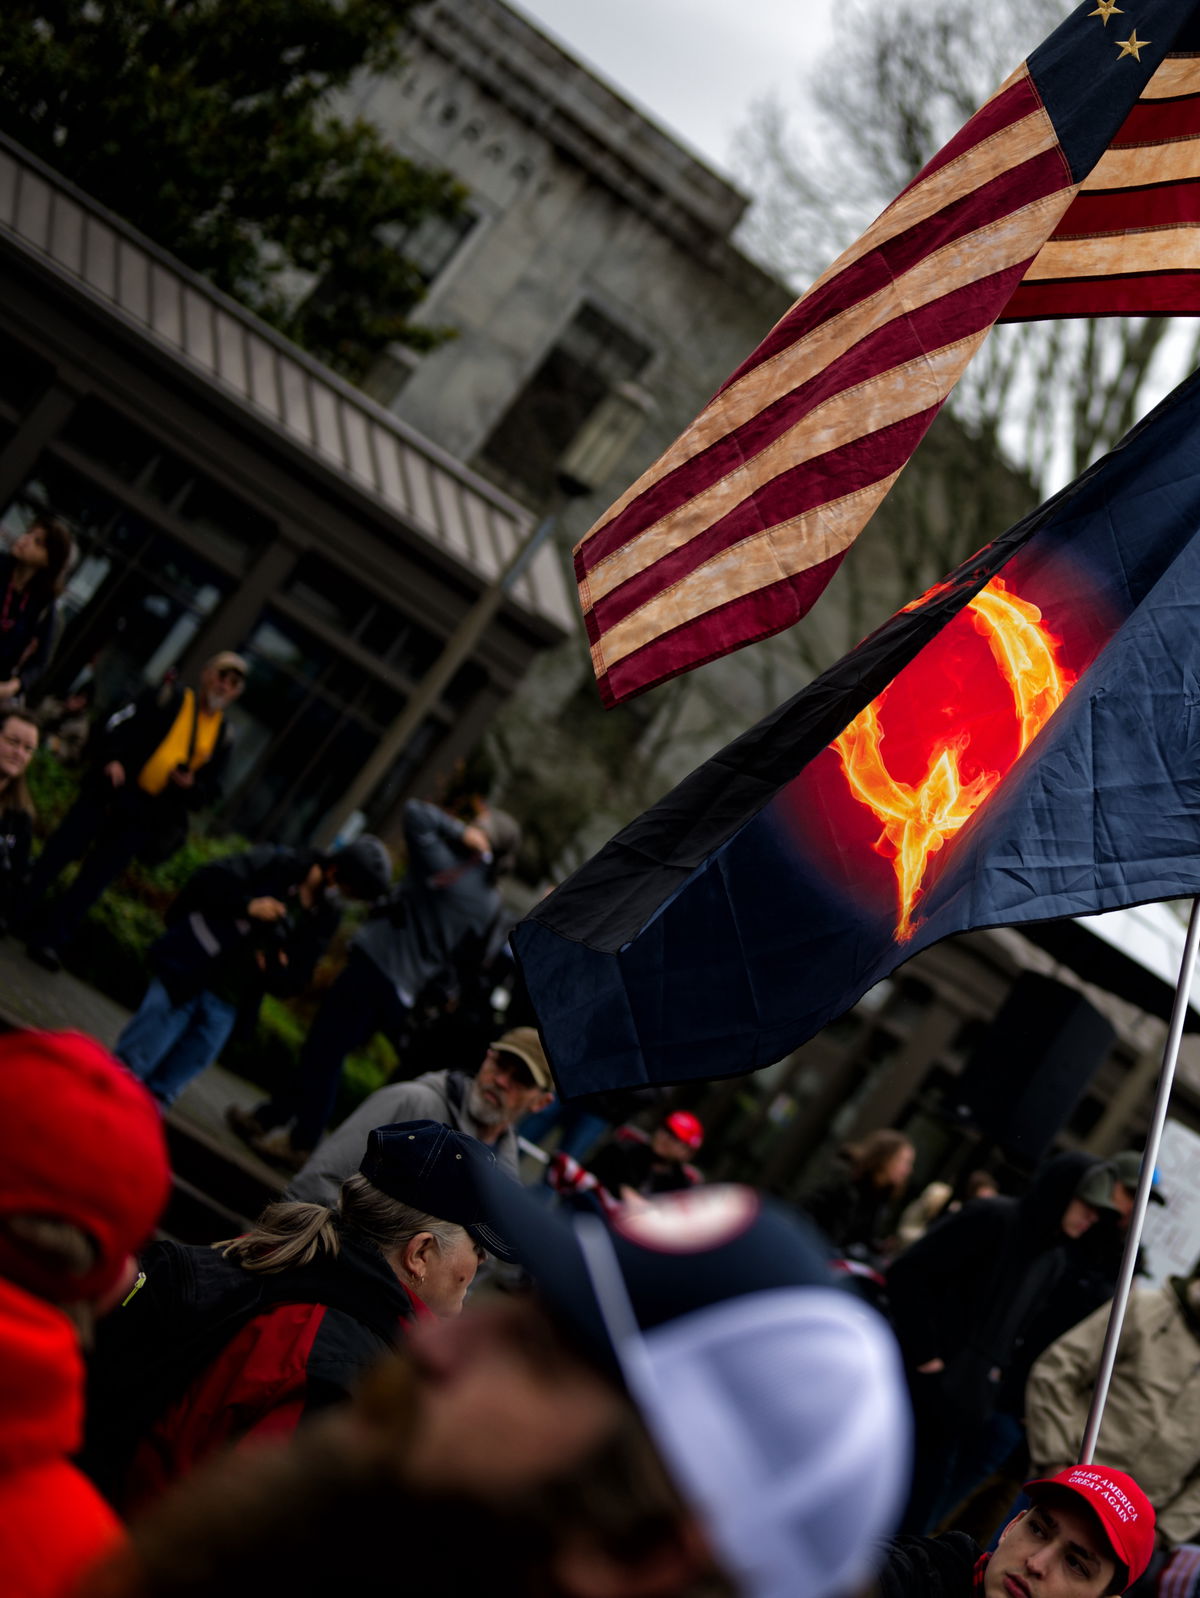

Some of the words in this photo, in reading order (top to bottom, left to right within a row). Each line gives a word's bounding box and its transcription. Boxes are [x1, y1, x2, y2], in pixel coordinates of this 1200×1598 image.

[1068, 1477, 1103, 1491] GREAT
[1100, 1491, 1129, 1523] AGAIN
[1071, 1470, 1101, 1481] MAKE
[1100, 1479, 1138, 1522] AMERICA
